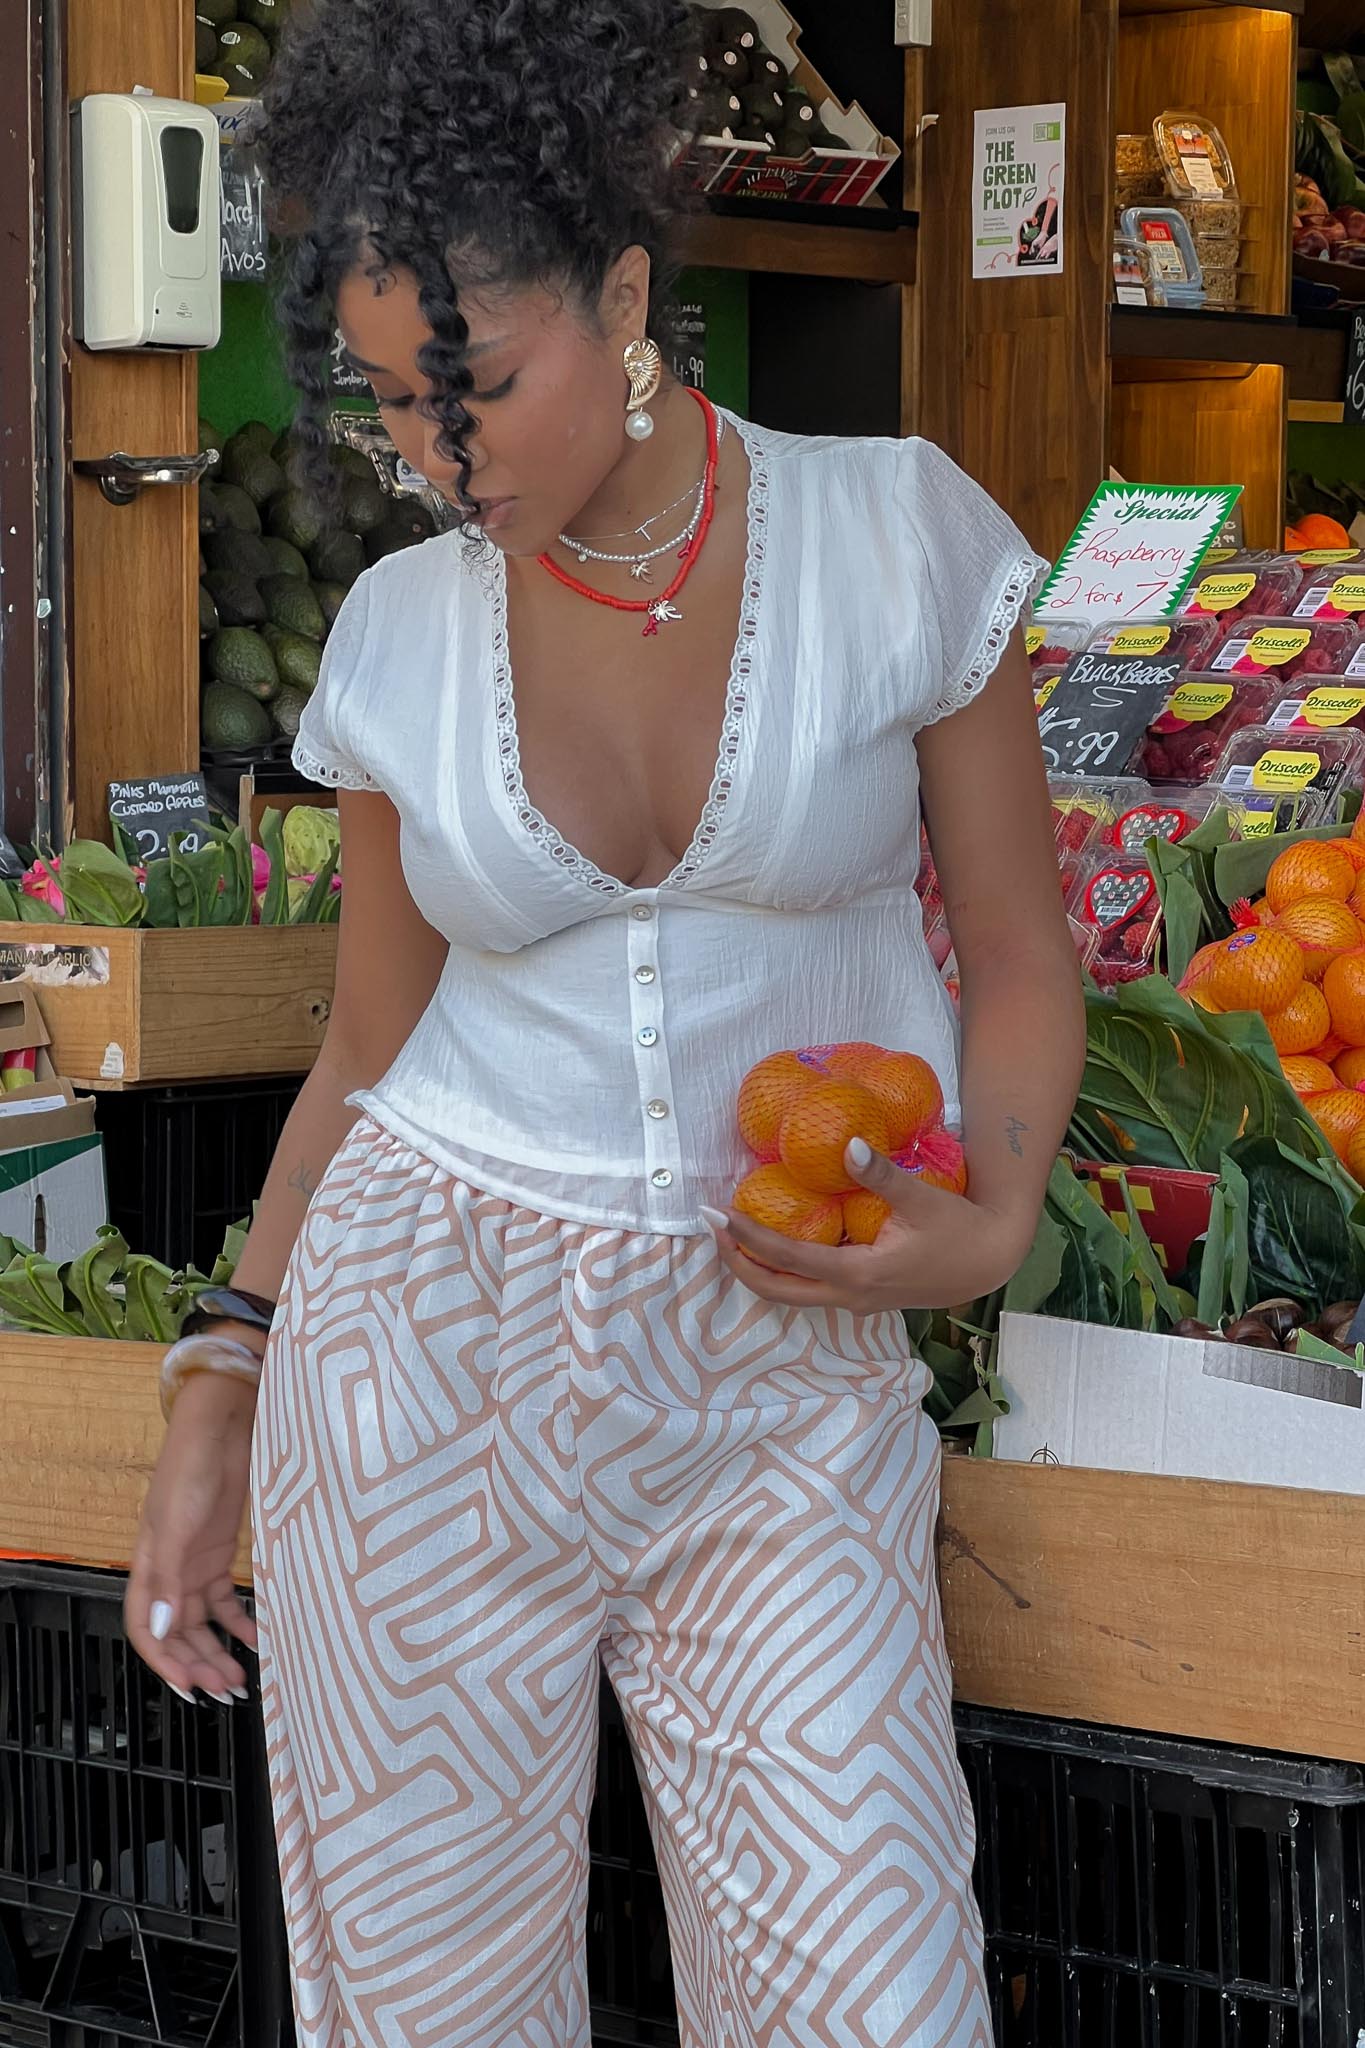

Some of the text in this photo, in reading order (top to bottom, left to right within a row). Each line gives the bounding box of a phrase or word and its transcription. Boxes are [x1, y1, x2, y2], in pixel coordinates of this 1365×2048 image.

[986, 127, 998, 136] JOIN
[985, 140, 1015, 163] THE
[983, 162, 1036, 187] GREEN
[983, 187, 1022, 211] PLOT
[220, 237, 267, 273] Avos
[332, 365, 369, 386] Jumbos
[1113, 500, 1209, 525] Special
[1076, 527, 1186, 578] Raspberry
[1050, 576, 1083, 609] 2
[1084, 582, 1115, 605] for
[1200, 582, 1251, 594] Driscoll's
[1115, 635, 1166, 647] Driscoll's
[1251, 636, 1306, 648] Driscoll's
[1174, 691, 1229, 704] Driscoll's
[1305, 696, 1362, 708] Driscoll's
[1259, 760, 1318, 775] Driscoll's
[109, 783, 145, 799] PINKS
[165, 795, 206, 811] APPLES
